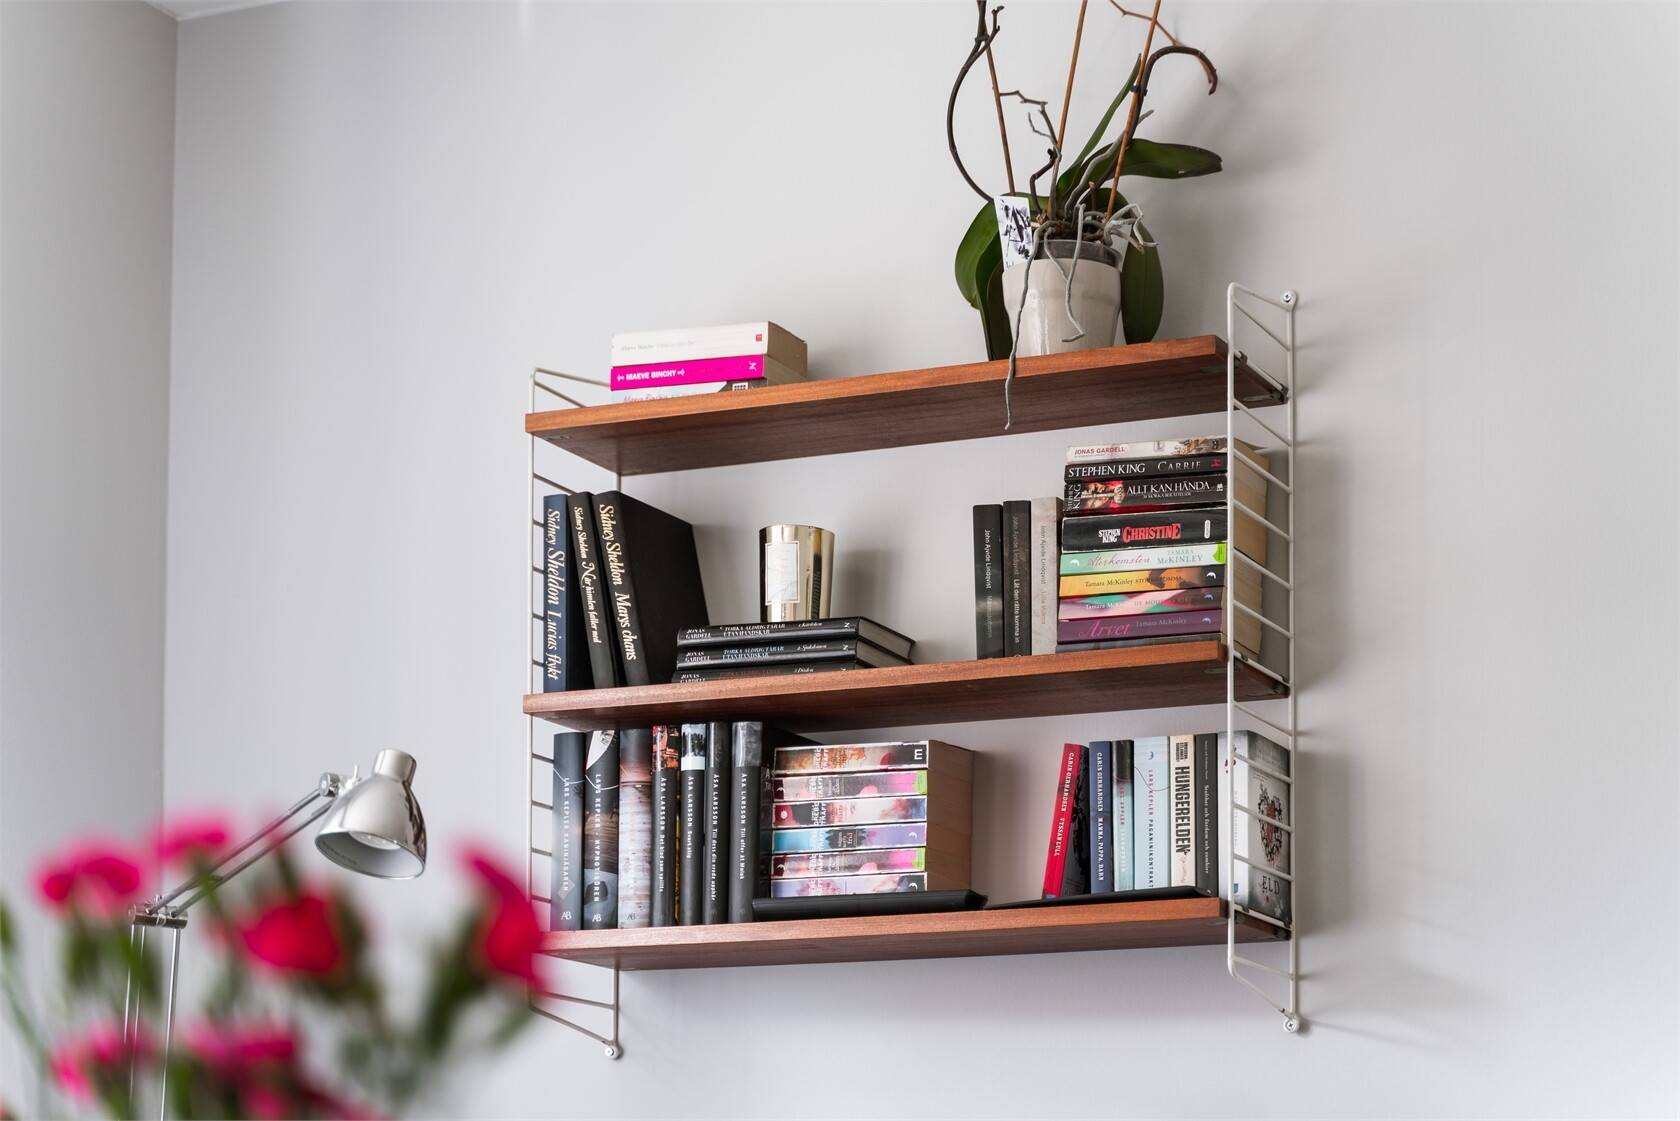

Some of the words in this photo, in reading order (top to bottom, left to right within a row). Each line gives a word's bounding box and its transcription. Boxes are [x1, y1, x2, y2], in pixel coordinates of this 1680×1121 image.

[626, 372, 650, 381] MAEVE
[651, 370, 677, 380] BINCHY
[1096, 446, 1126, 454] GARDELL
[1068, 465, 1116, 478] STEPHEN
[1118, 463, 1146, 475] KING
[1073, 484, 1082, 509] KING
[1127, 485, 1147, 496] ALLT
[1150, 483, 1173, 493] KAN
[1174, 481, 1211, 492] HÄNDA
[546, 509, 560, 545] Sidney
[574, 507, 586, 531] Sidney
[599, 504, 616, 541] Sidney
[1102, 535, 1118, 543] KING
[1122, 523, 1182, 543] CHRISTINE
[577, 531, 589, 559] Sheldon
[983, 544, 991, 562] Ajvide
[606, 542, 625, 585] Sheldon
[1157, 554, 1203, 564] McKINLEY
[547, 548, 566, 605] Sheldon
[580, 561, 596, 588] När
[983, 563, 992, 589] Lindqvist
[1013, 578, 1021, 589] Låt
[1107, 578, 1133, 587] McKinley
[583, 586, 596, 611] himlen
[614, 592, 632, 628] Marys
[547, 610, 562, 650] Lucias
[588, 611, 599, 630] faller
[1136, 620, 1158, 628] Tamara
[1159, 618, 1187, 627] McKinley
[592, 630, 602, 644] ned
[739, 629, 770, 637] HANDSKAR
[622, 630, 638, 661] chans
[738, 652, 769, 660] HANDSKAR
[545, 653, 562, 680] flykt
[712, 774, 720, 788] ÅSA
[1061, 772, 1072, 812] GERHARDSEN
[1175, 766, 1191, 854] HUNGERELDEN
[1054, 841, 1062, 857] LULL
[1262, 875, 1280, 895] ELD
